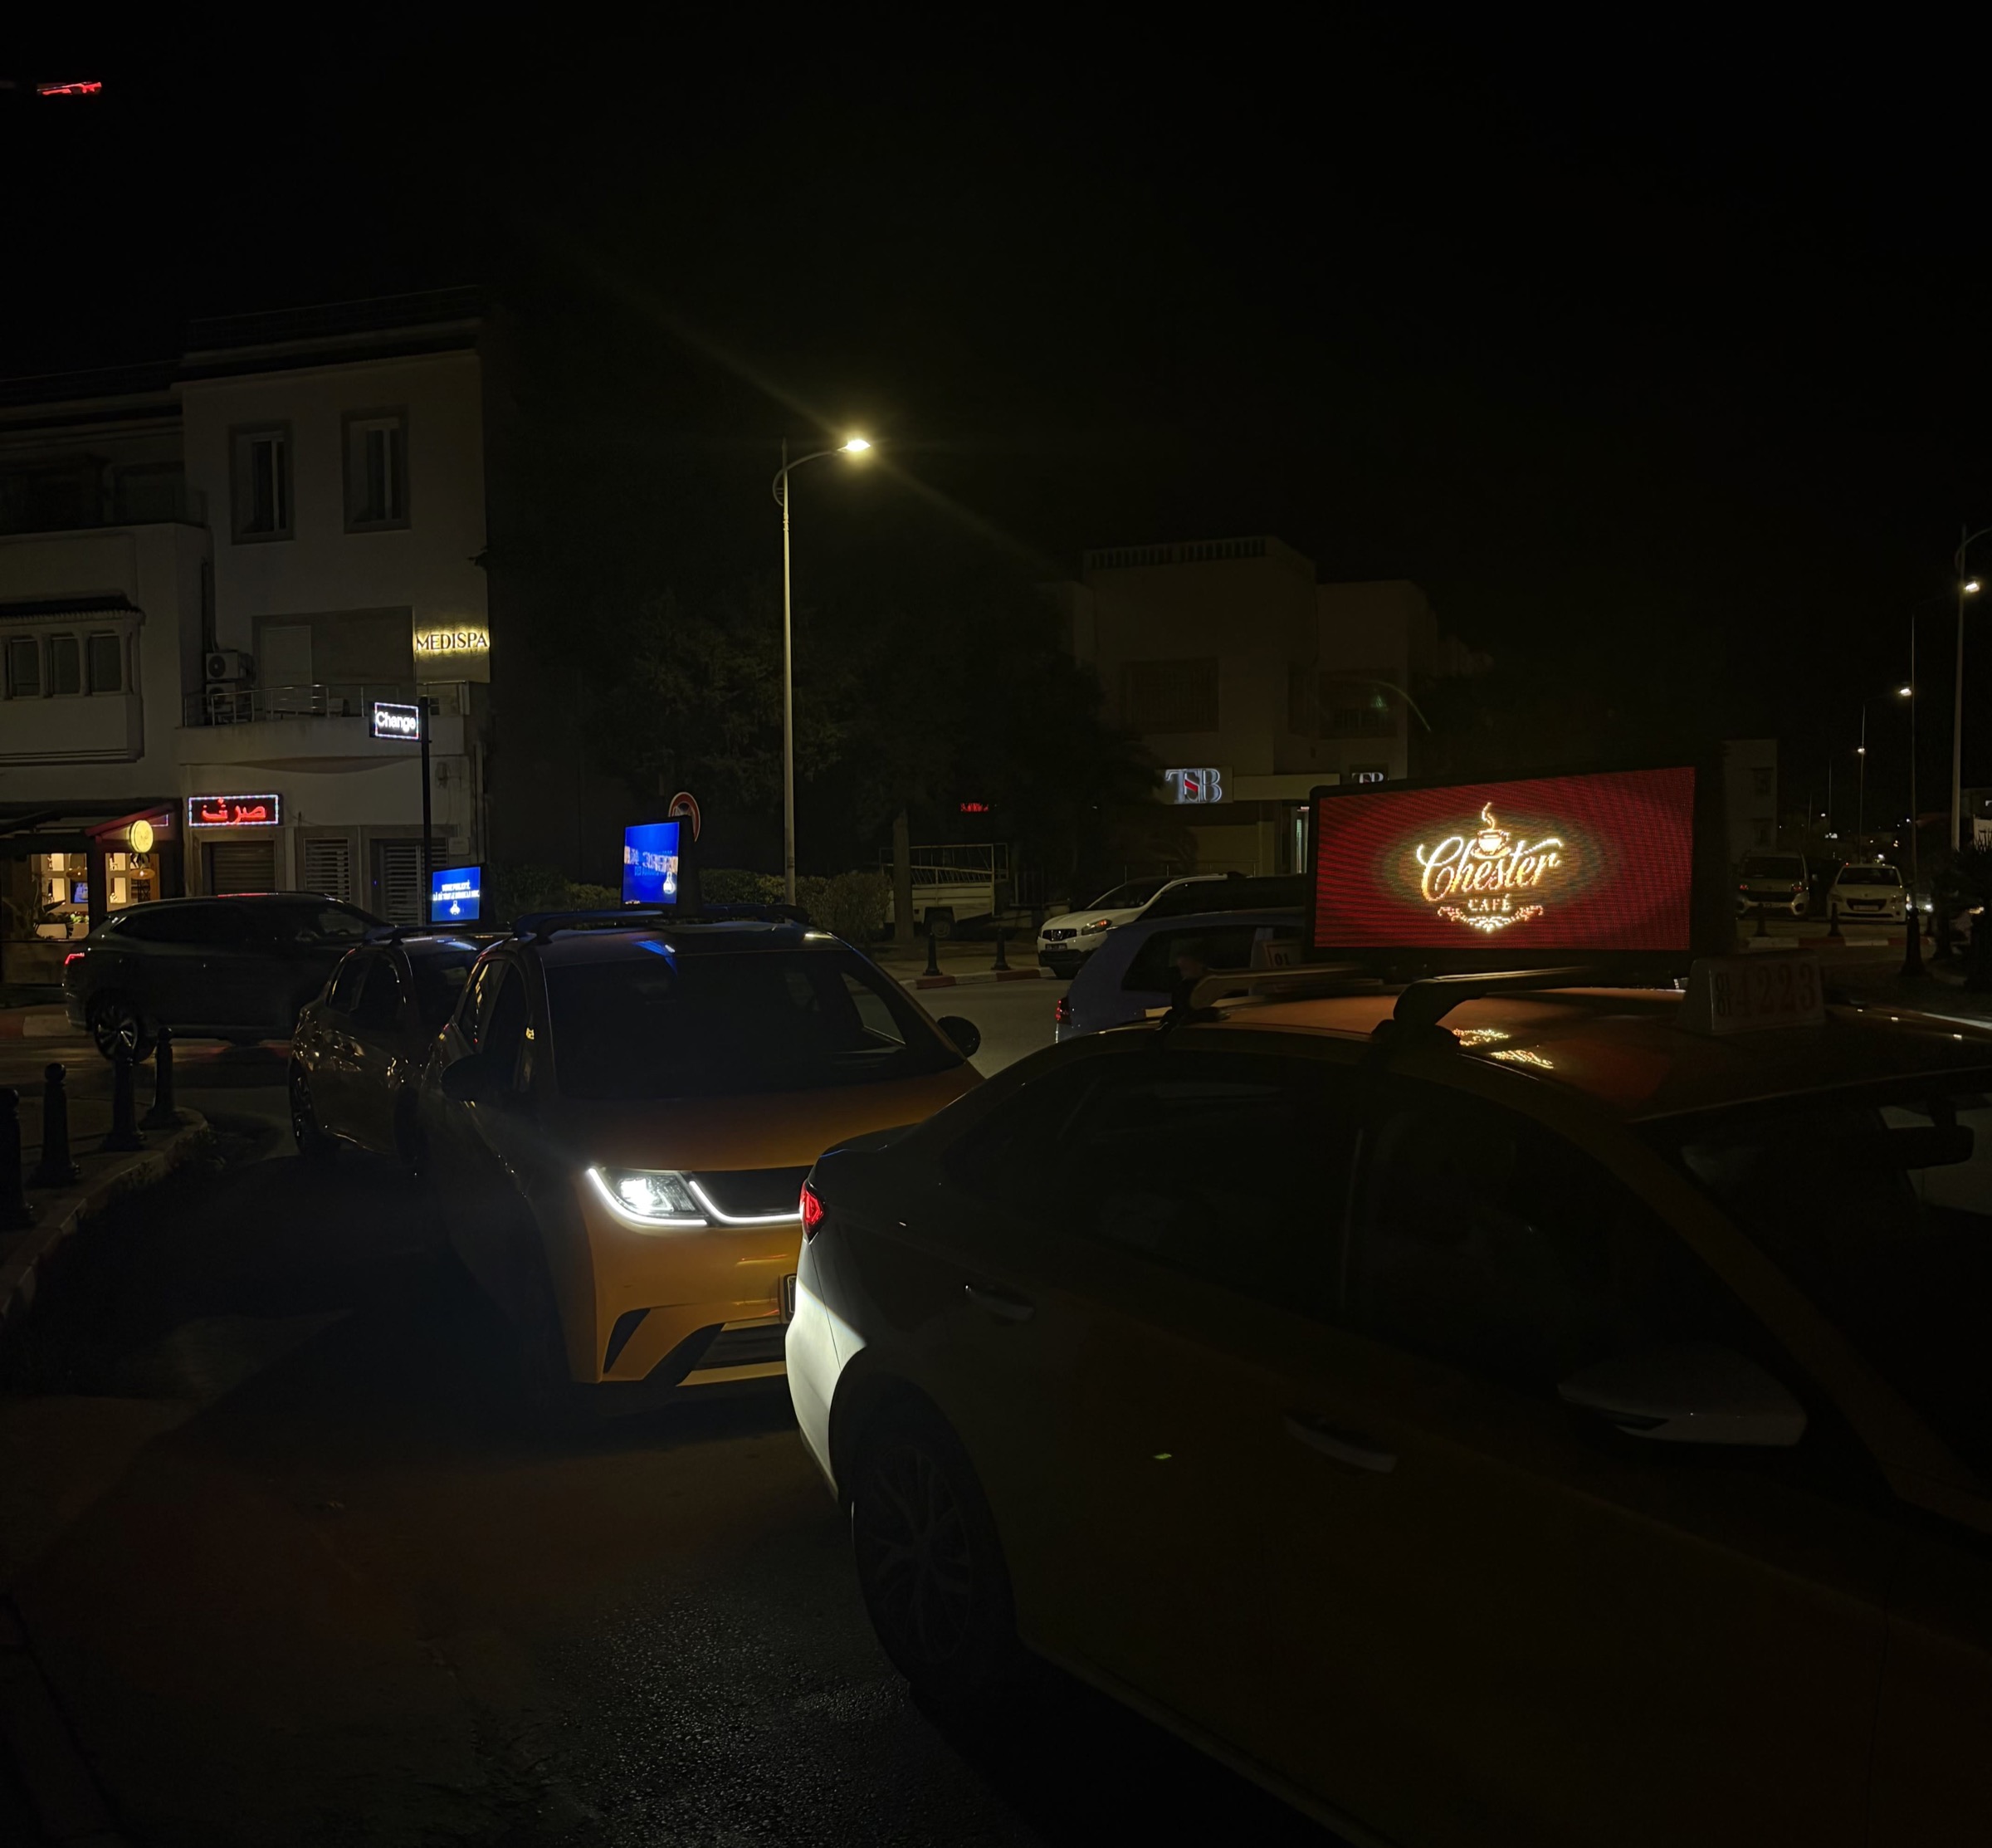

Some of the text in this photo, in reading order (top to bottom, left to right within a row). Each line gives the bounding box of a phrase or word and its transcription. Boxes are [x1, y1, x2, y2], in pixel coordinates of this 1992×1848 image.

[416, 632, 488, 650] MEDISPA
[375, 711, 416, 733] Change
[1164, 768, 1223, 804] TSB
[1416, 836, 1564, 902] Chester
[1468, 893, 1512, 911] CAFÉ
